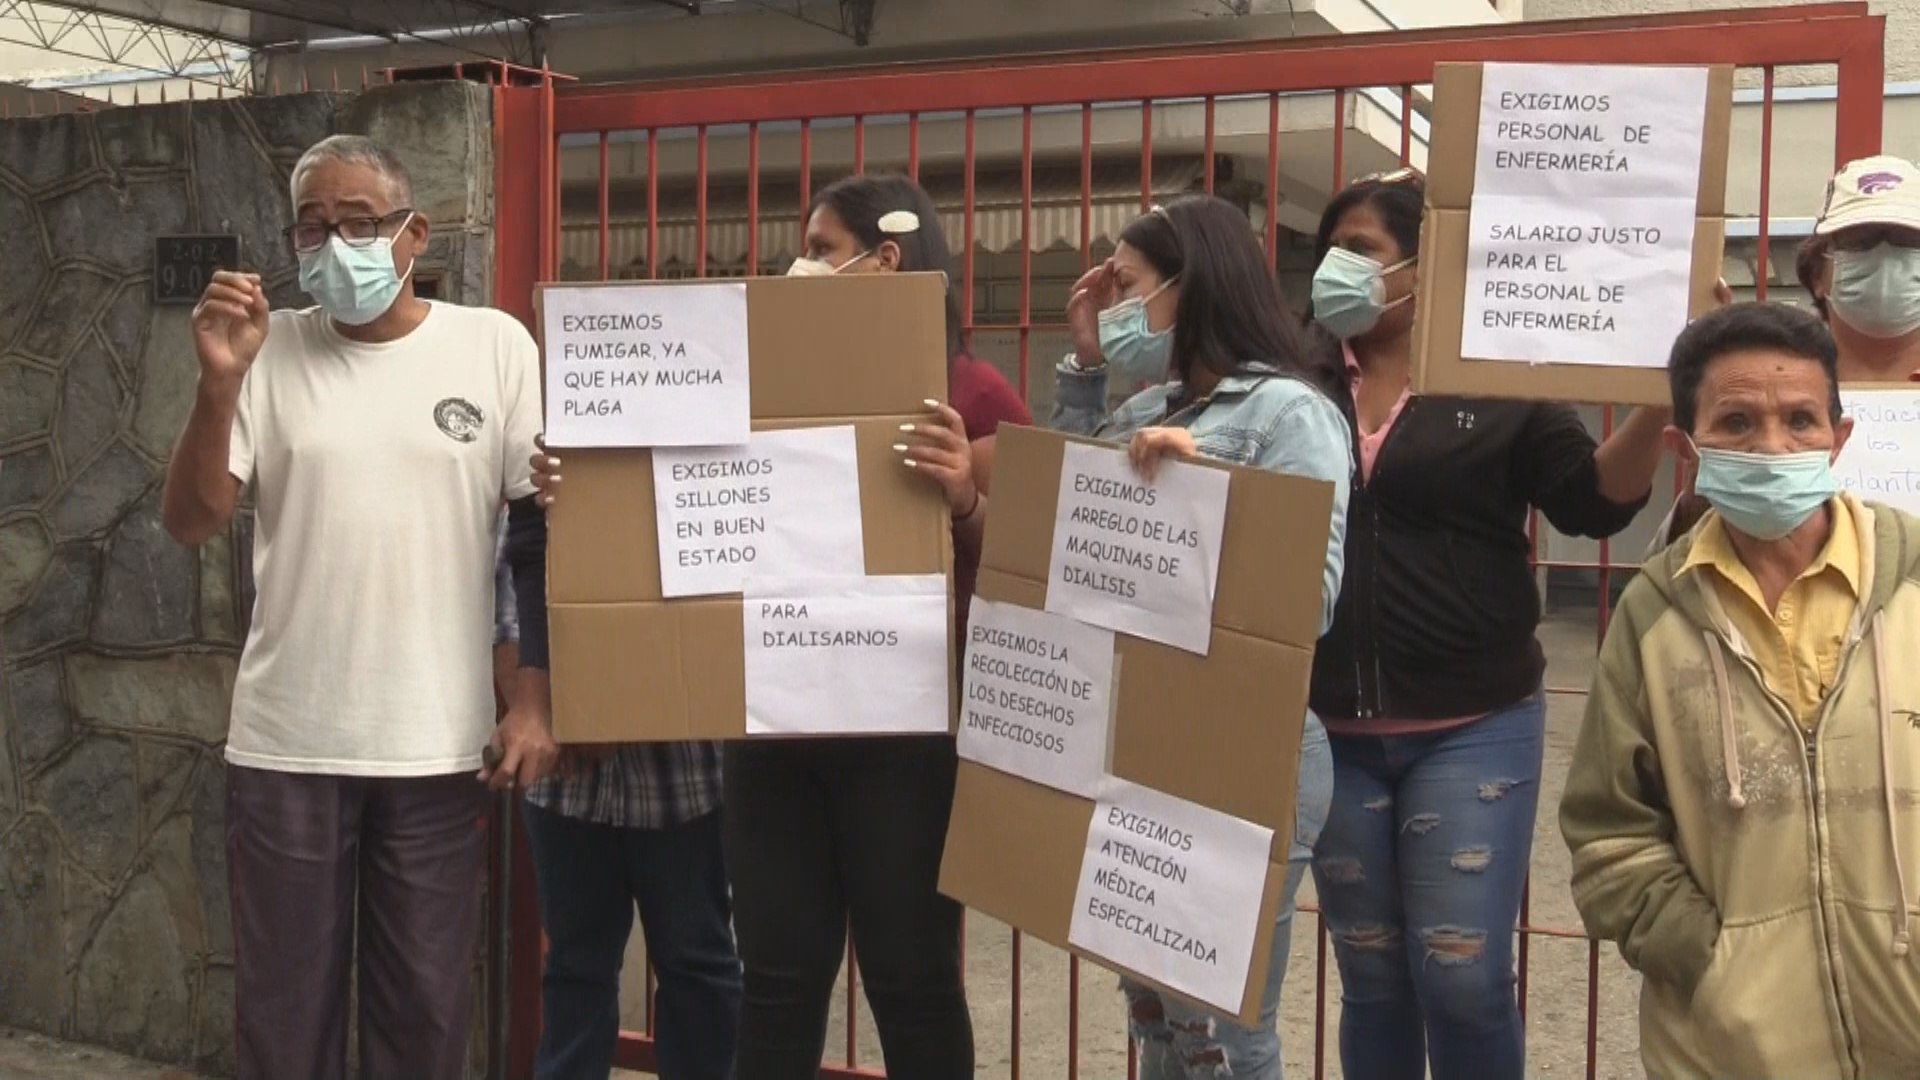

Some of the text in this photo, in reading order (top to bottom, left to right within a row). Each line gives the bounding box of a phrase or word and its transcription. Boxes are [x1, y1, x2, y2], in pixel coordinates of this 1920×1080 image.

[1500, 90, 1610, 113] EXIGIMOS
[1497, 120, 1651, 145] PERSONAL DE
[1495, 149, 1629, 172] ENFERMERÍA
[1489, 224, 1661, 245] SALARIO JUSTO
[1486, 250, 1568, 273] PARA EL
[1484, 280, 1625, 304] PERSONAL DE
[562, 313, 663, 333] EXIGIMOS
[1482, 309, 1616, 332] ENFERMERÍA
[563, 341, 687, 361] FUMIGAR, YA
[563, 368, 724, 391] QUE HAY MUCHA
[564, 398, 623, 417] PLAGA
[1867, 432, 1901, 451] los
[672, 458, 773, 482] EXIGIMOS
[675, 486, 771, 509] SILLONES
[1074, 473, 1156, 507] EXIGIMOS
[676, 516, 765, 539] EN BUEN
[1071, 506, 1198, 548] ARREGLO DE LAS
[678, 545, 757, 567] ESTADO
[1065, 536, 1179, 577] MAQUINAS DE
[1063, 565, 1136, 598] DIALISIS
[761, 603, 809, 620] PARA
[762, 629, 899, 648] DIALISARNOS
[971, 625, 1068, 662] EXIGIMOS LA
[970, 654, 1092, 701] RECOLECCIÓN DE
[968, 683, 1074, 726] LOS DESECHOS
[967, 712, 1065, 753] INFECCIOSOS
[1107, 806, 1193, 851] EXIGIMOS
[1100, 839, 1187, 883] ATENCIÓN
[1093, 868, 1155, 906] MÉDICA
[1088, 899, 1216, 965] ESPECIALIZADA
